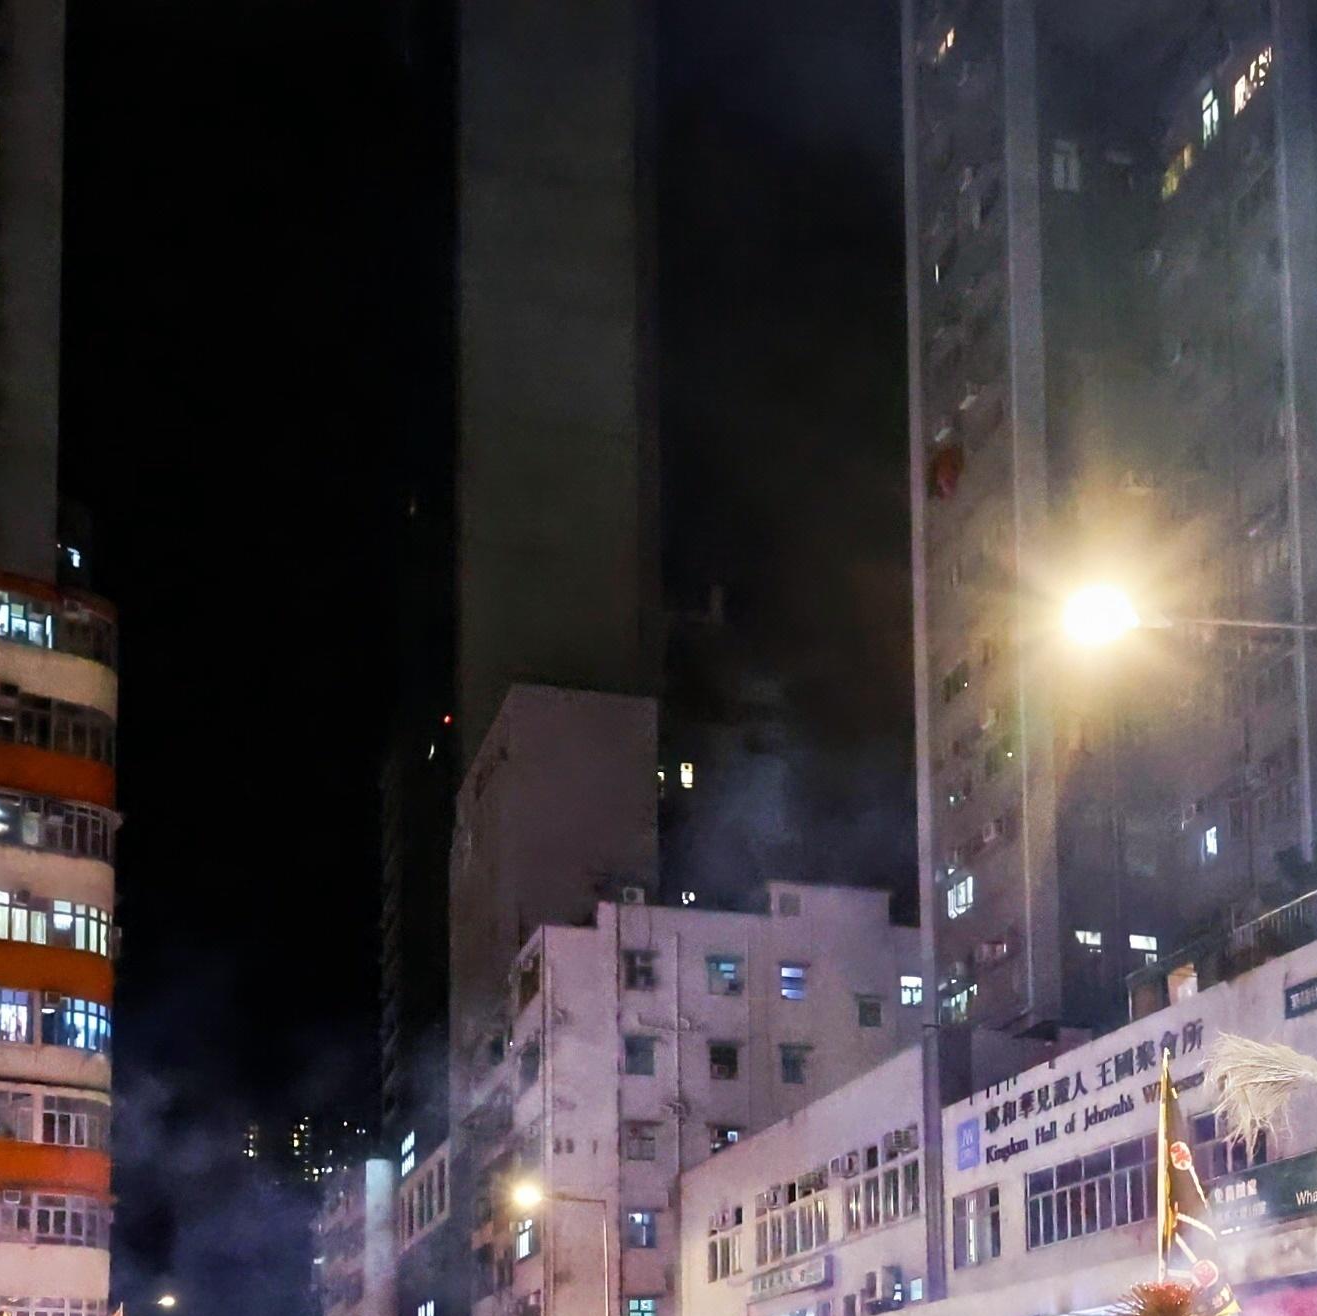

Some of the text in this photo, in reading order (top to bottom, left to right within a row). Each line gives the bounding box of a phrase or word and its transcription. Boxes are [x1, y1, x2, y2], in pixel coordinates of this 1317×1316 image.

[986, 1137, 1029, 1174] Kingdom
[1035, 1120, 1058, 1156] Hall
[1064, 1115, 1076, 1135] of
[1084, 1094, 1134, 1132] Jehovah's
